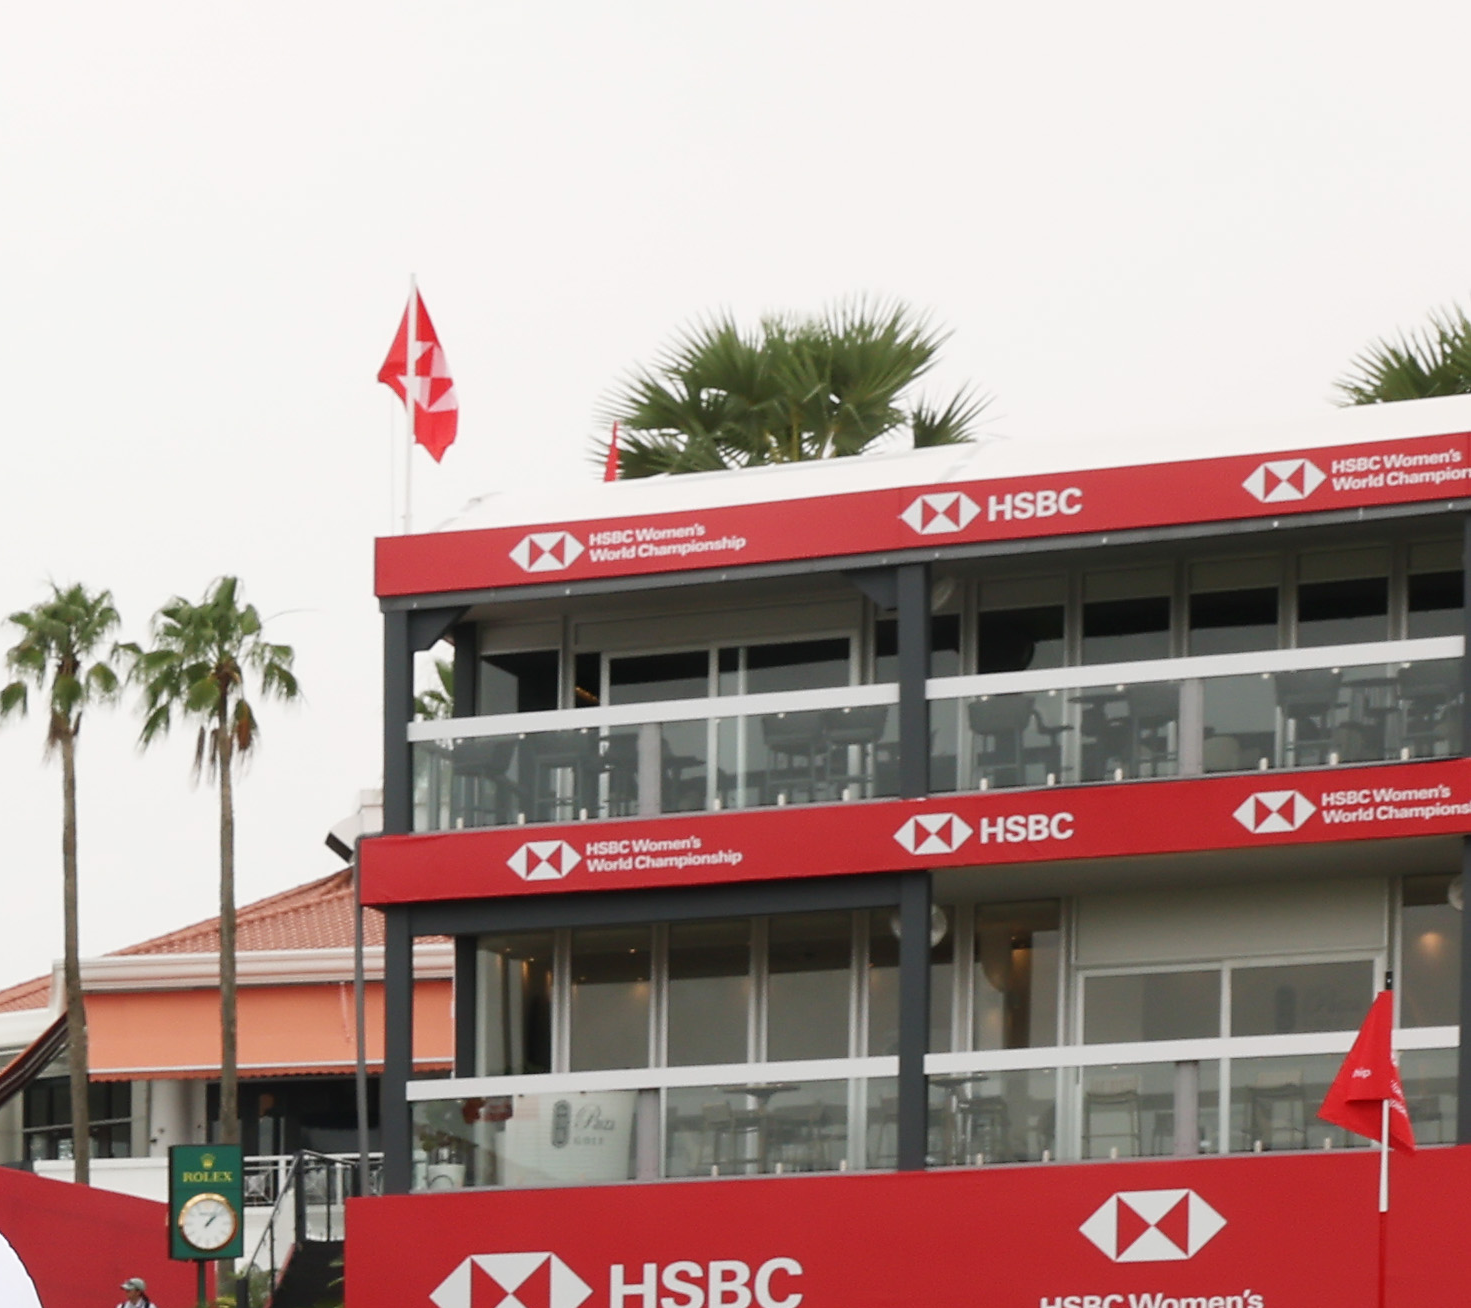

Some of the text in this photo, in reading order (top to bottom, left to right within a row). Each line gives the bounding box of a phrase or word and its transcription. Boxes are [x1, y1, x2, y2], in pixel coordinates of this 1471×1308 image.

[1331, 448, 1462, 474] HSBC Women's
[1333, 466, 1471, 492] World Champion
[988, 487, 1083, 522] HSBC
[589, 522, 705, 547] HSBC Women's
[589, 535, 747, 563] World Championship
[1321, 783, 1452, 808] HSBC Women's
[1322, 801, 1471, 824] World Champions
[980, 812, 1074, 844] HSBC
[586, 836, 702, 857] HSBC Women's
[587, 850, 743, 873] World Championship
[182, 1172, 233, 1183] ROLEX
